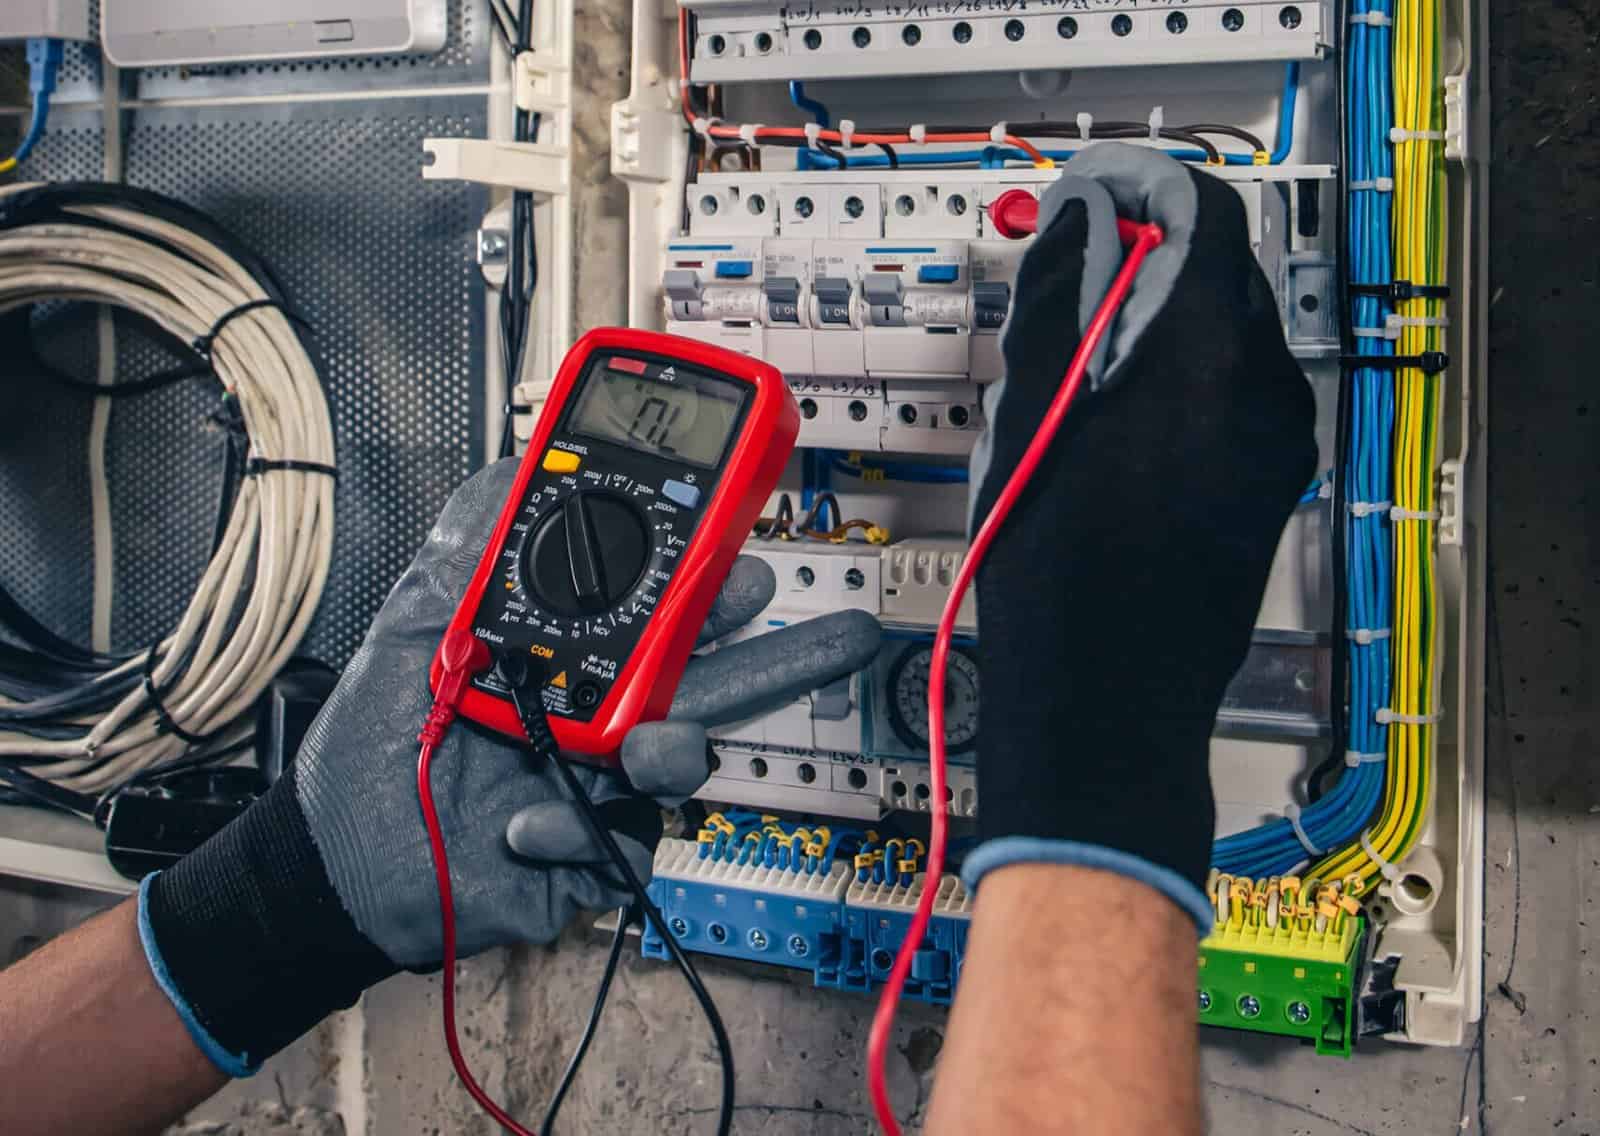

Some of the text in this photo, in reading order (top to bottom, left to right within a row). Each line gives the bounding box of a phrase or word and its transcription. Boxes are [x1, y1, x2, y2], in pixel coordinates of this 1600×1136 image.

[613, 473, 627, 482] OFF
[661, 547, 678, 558] 200
[618, 613, 633, 625] 200
[592, 623, 611, 637] NCV
[530, 644, 555, 660] COM
